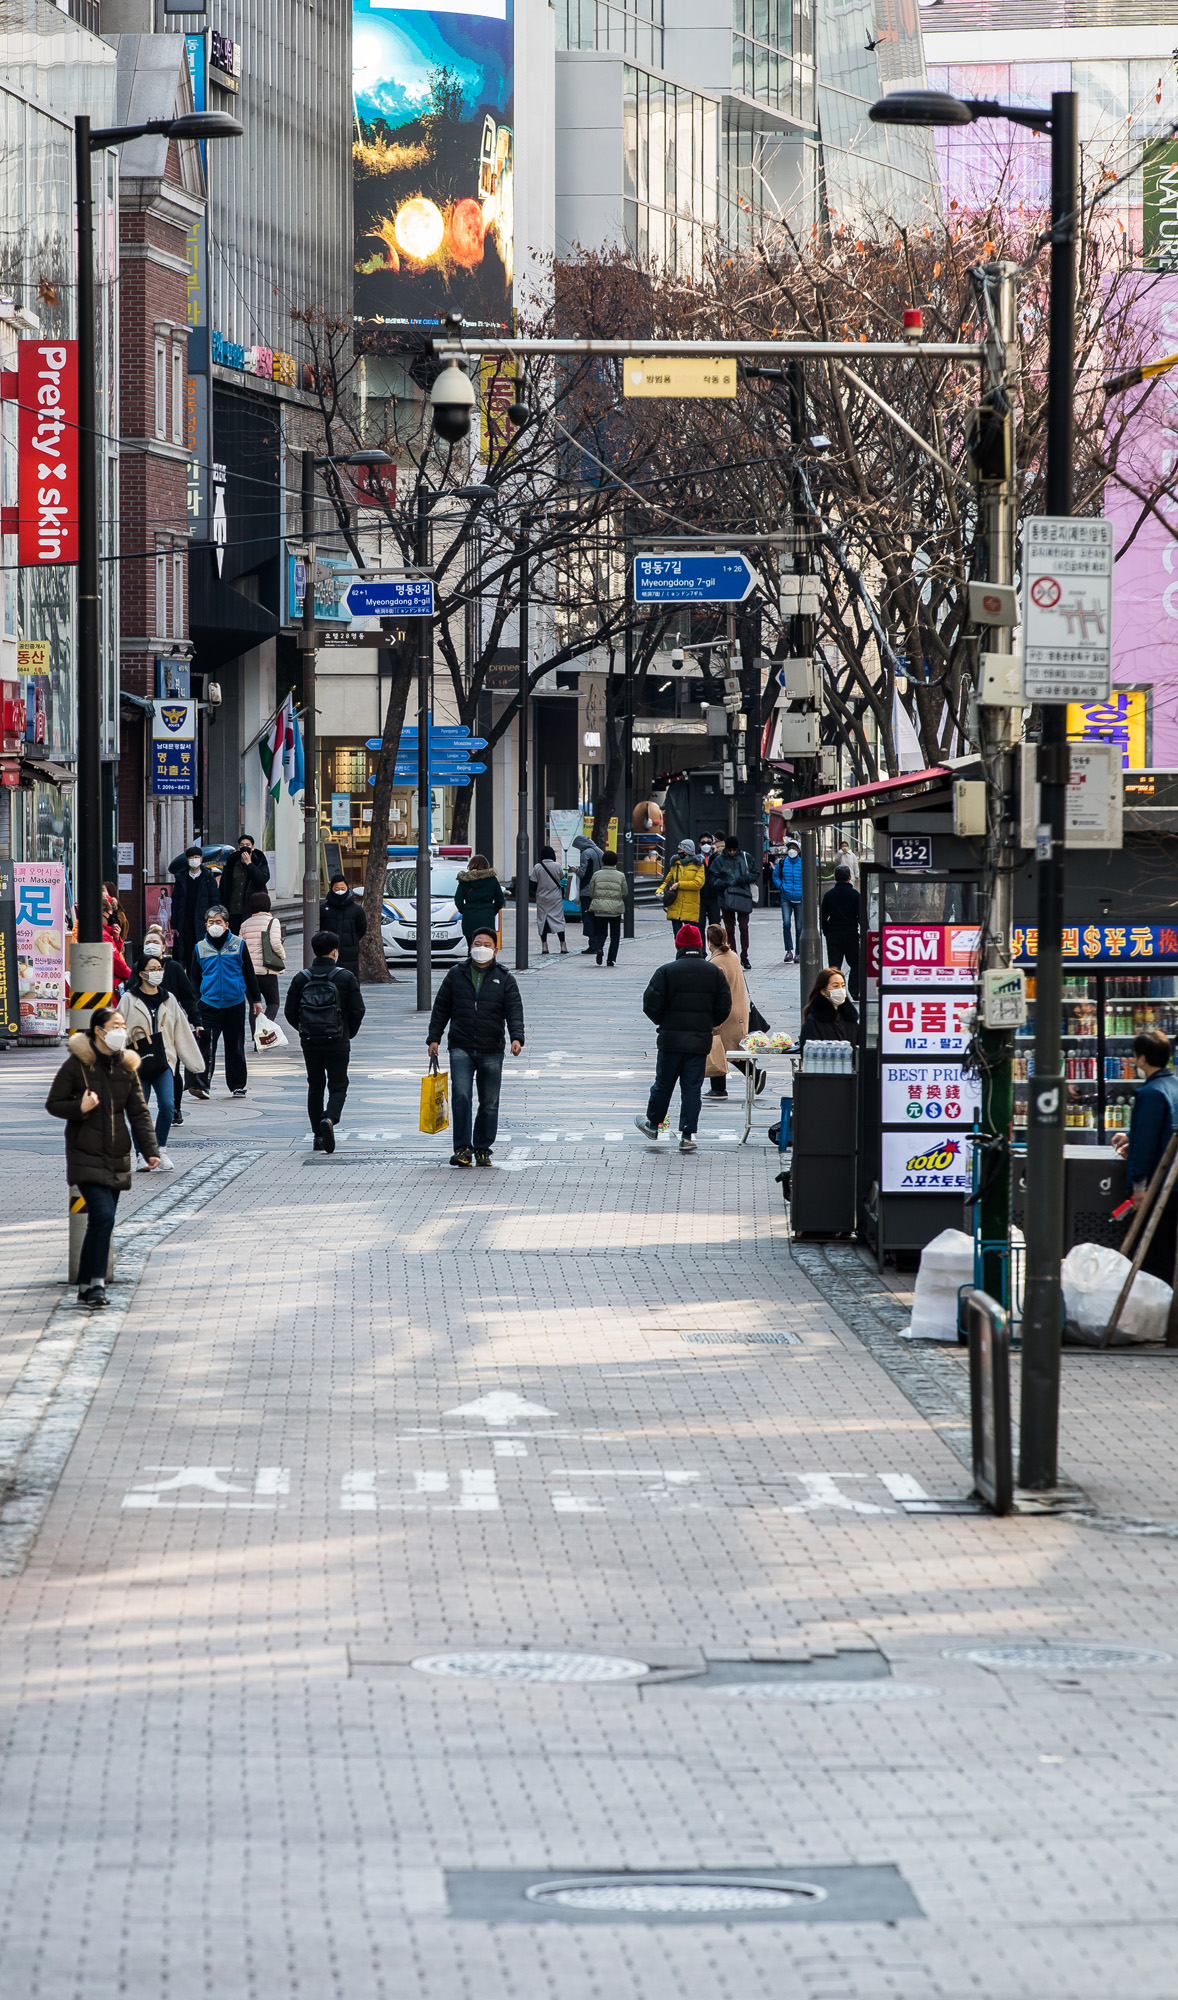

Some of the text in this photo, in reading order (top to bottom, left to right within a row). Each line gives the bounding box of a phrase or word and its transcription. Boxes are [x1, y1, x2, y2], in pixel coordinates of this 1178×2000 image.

[1159, 165, 1178, 272] NATURE
[646, 374, 671, 384] 방범용
[703, 374, 719, 384] 작동
[723, 374, 731, 384] 중
[32, 347, 67, 458] Pretty
[38, 487, 68, 559] skin
[641, 560, 682, 575] 명동7길
[641, 578, 715, 587] Myeongdong 7-gil
[395, 584, 430, 596] 명동8길
[365, 598, 431, 607] Myeongdong 8-gil
[17, 650, 45, 666] 동산
[157, 765, 190, 776] 파출소
[895, 846, 928, 860] 43-2
[30, 868, 60, 876] 오아시스
[30, 877, 60, 885] Massage
[16, 886, 54, 926] 足
[885, 936, 938, 961] SIM
[905, 1038, 962, 1049] 사고 팔고
[888, 1069, 928, 1082] BEST
[906, 1150, 954, 1171] toto
[901, 1175, 966, 1187] 스포츠토토
